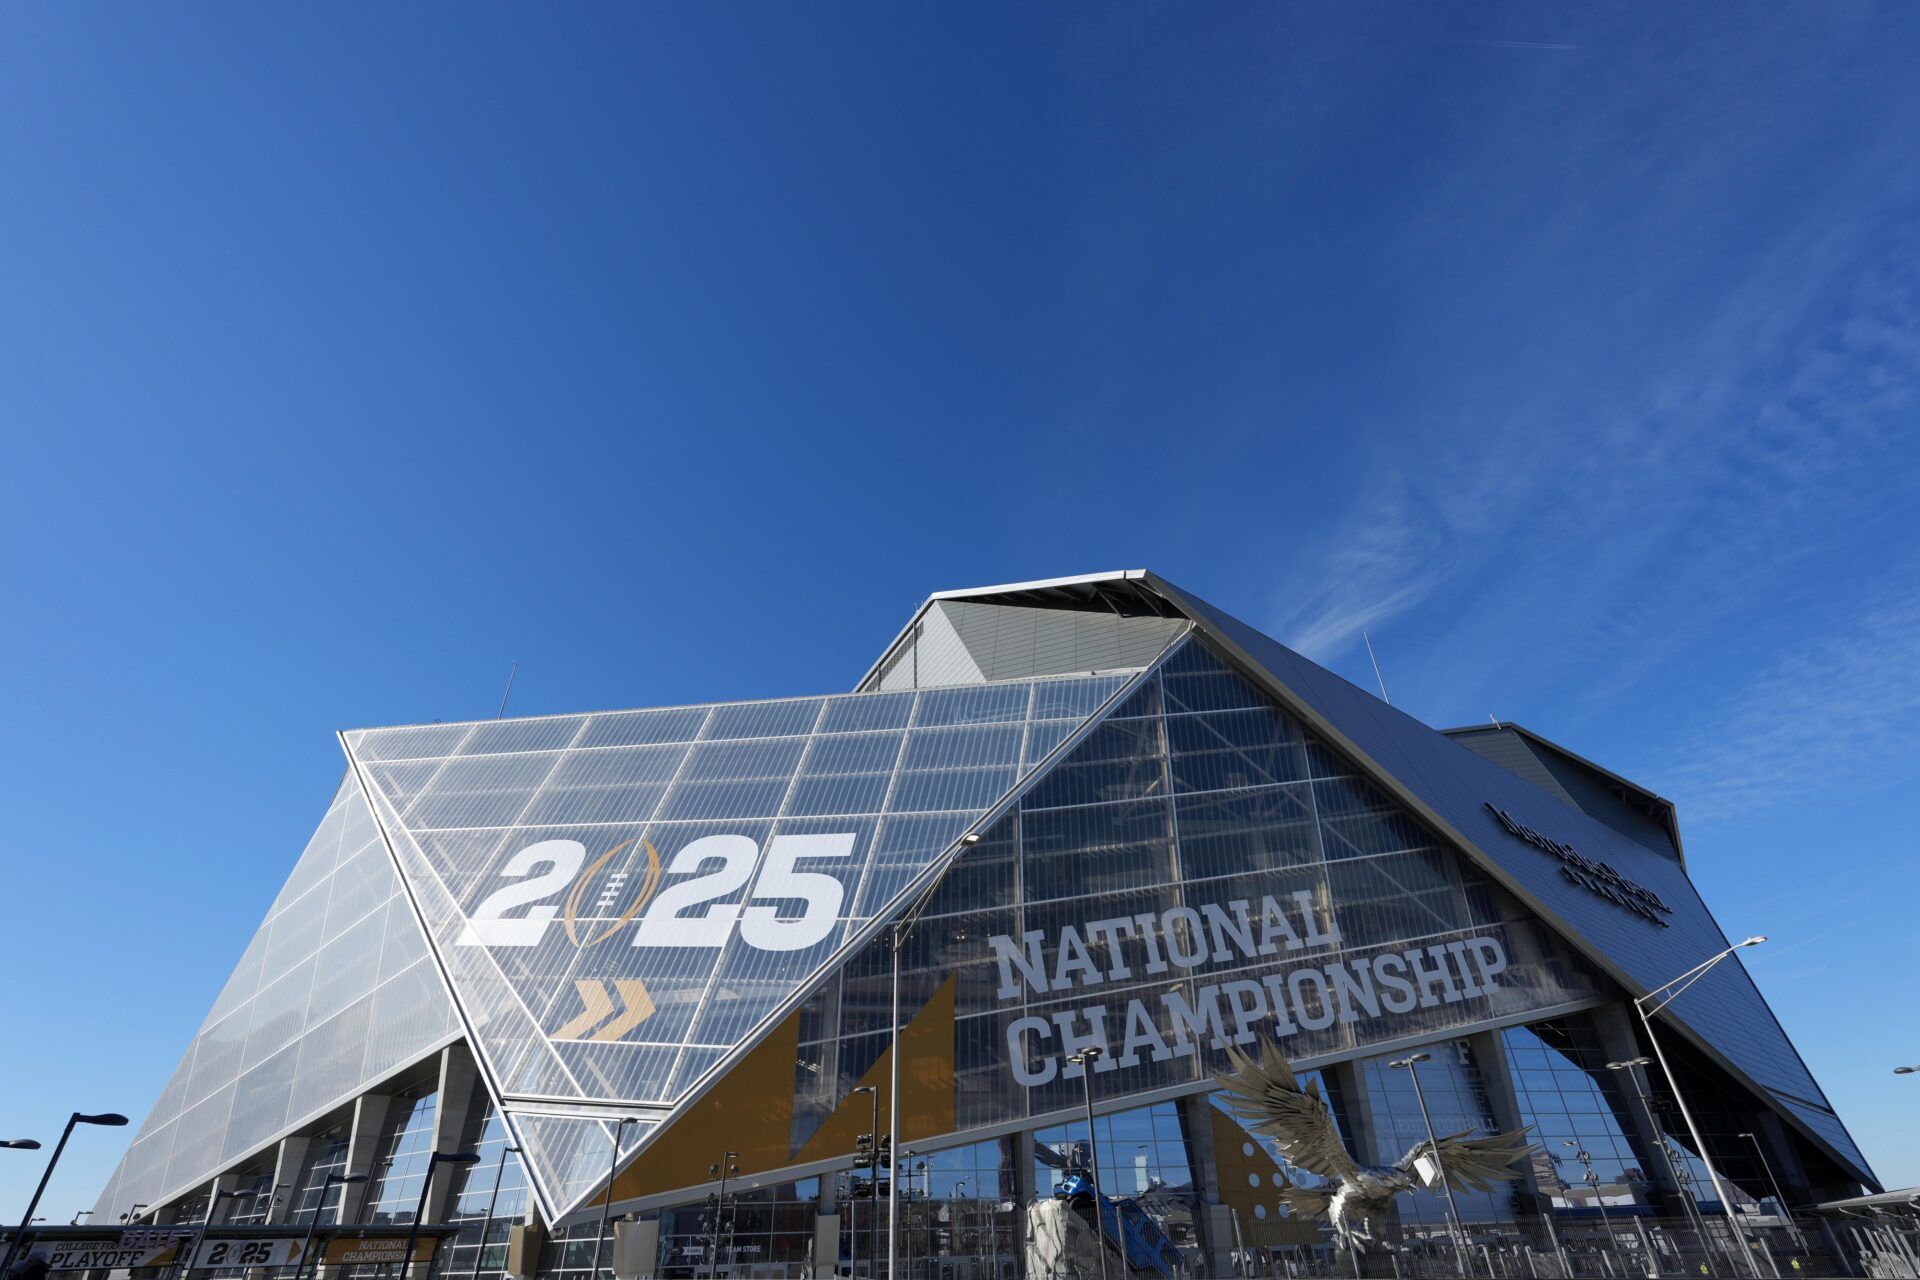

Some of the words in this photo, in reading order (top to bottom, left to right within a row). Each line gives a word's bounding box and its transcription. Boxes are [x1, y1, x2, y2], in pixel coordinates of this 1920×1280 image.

[988, 890, 1342, 1000] NATIONAL
[1006, 936, 1508, 1087] CHAMPIONSHIP
[55, 1242, 100, 1251] COLLEGE
[357, 1239, 409, 1250] NATIONAL
[742, 1245, 761, 1253] STORE
[48, 1250, 146, 1269] PLAYOFF
